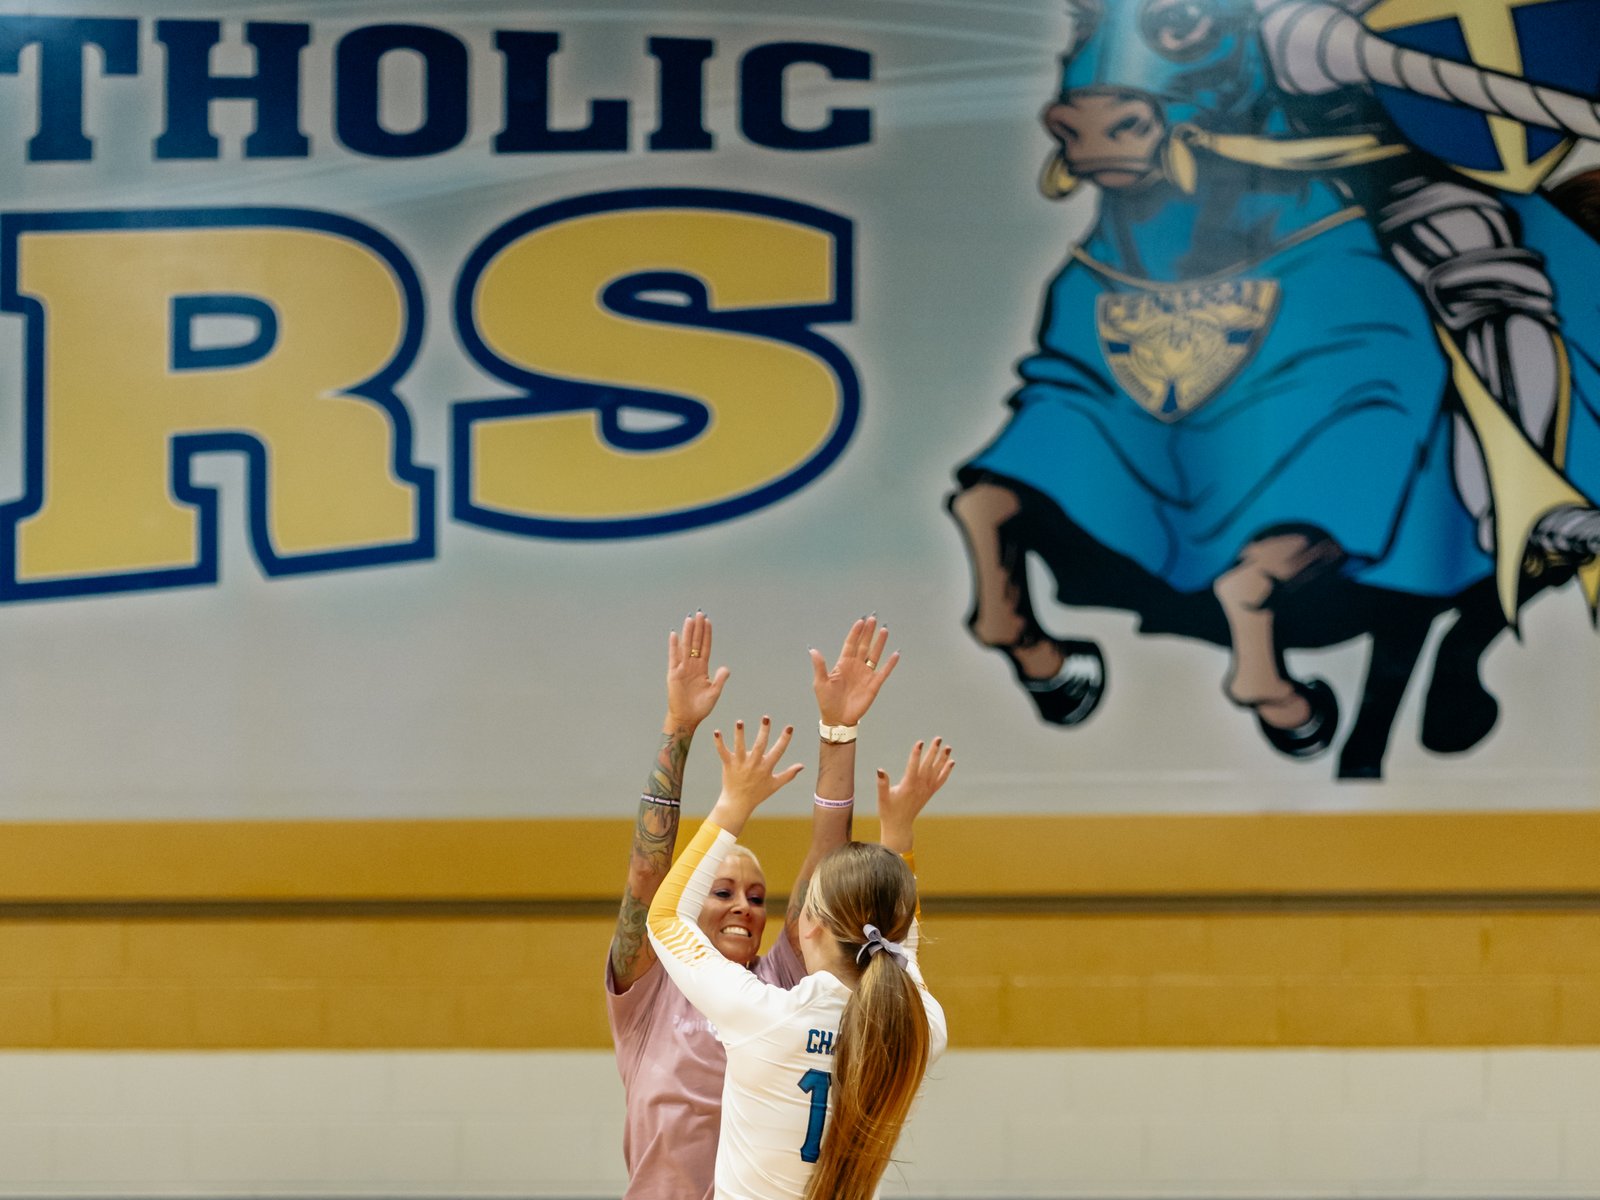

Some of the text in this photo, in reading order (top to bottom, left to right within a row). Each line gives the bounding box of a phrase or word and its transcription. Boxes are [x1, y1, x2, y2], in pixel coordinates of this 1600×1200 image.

[0, 17, 874, 162] THOLIC
[0, 187, 861, 602] RS
[806, 1028, 835, 1055] CH
